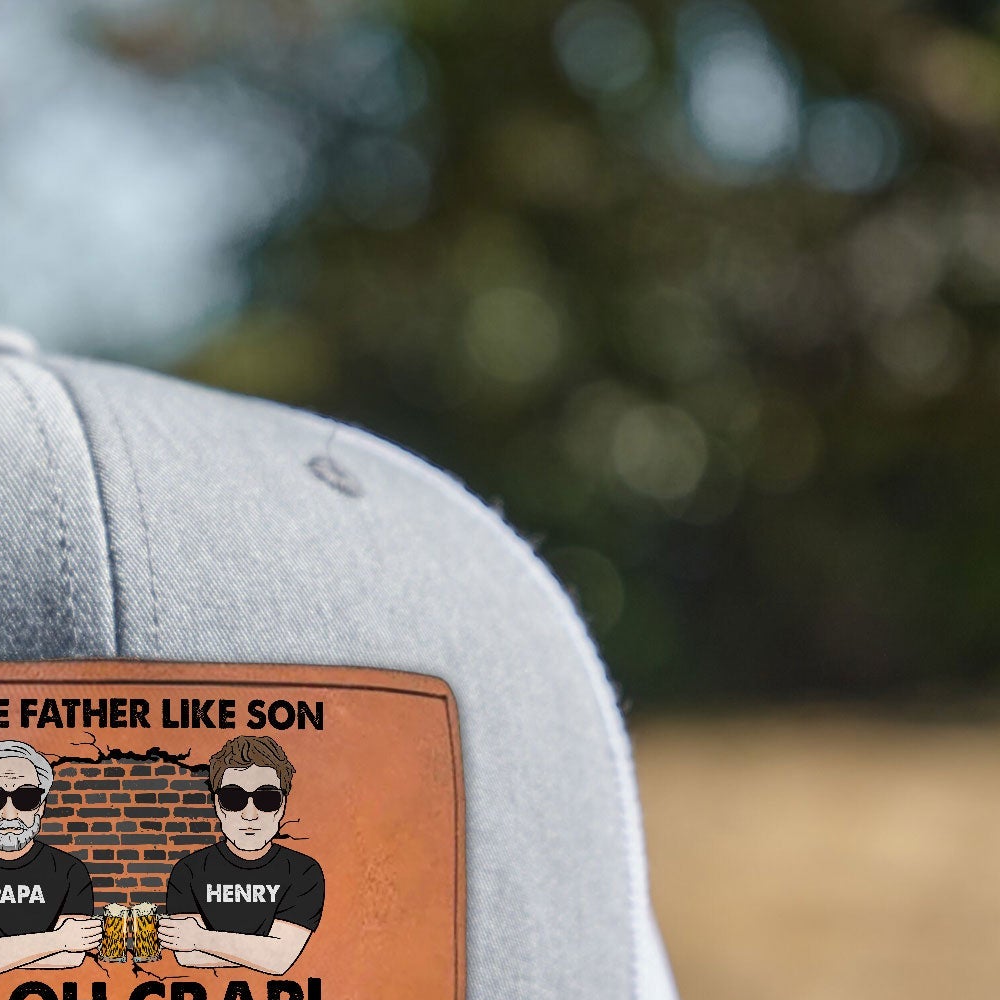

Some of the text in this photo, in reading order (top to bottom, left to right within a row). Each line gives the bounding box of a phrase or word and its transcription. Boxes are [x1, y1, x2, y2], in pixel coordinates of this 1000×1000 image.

[21, 698, 151, 729] FATHER
[162, 699, 235, 729] LIKE
[247, 699, 323, 730] SON
[206, 883, 281, 903] HENRY
